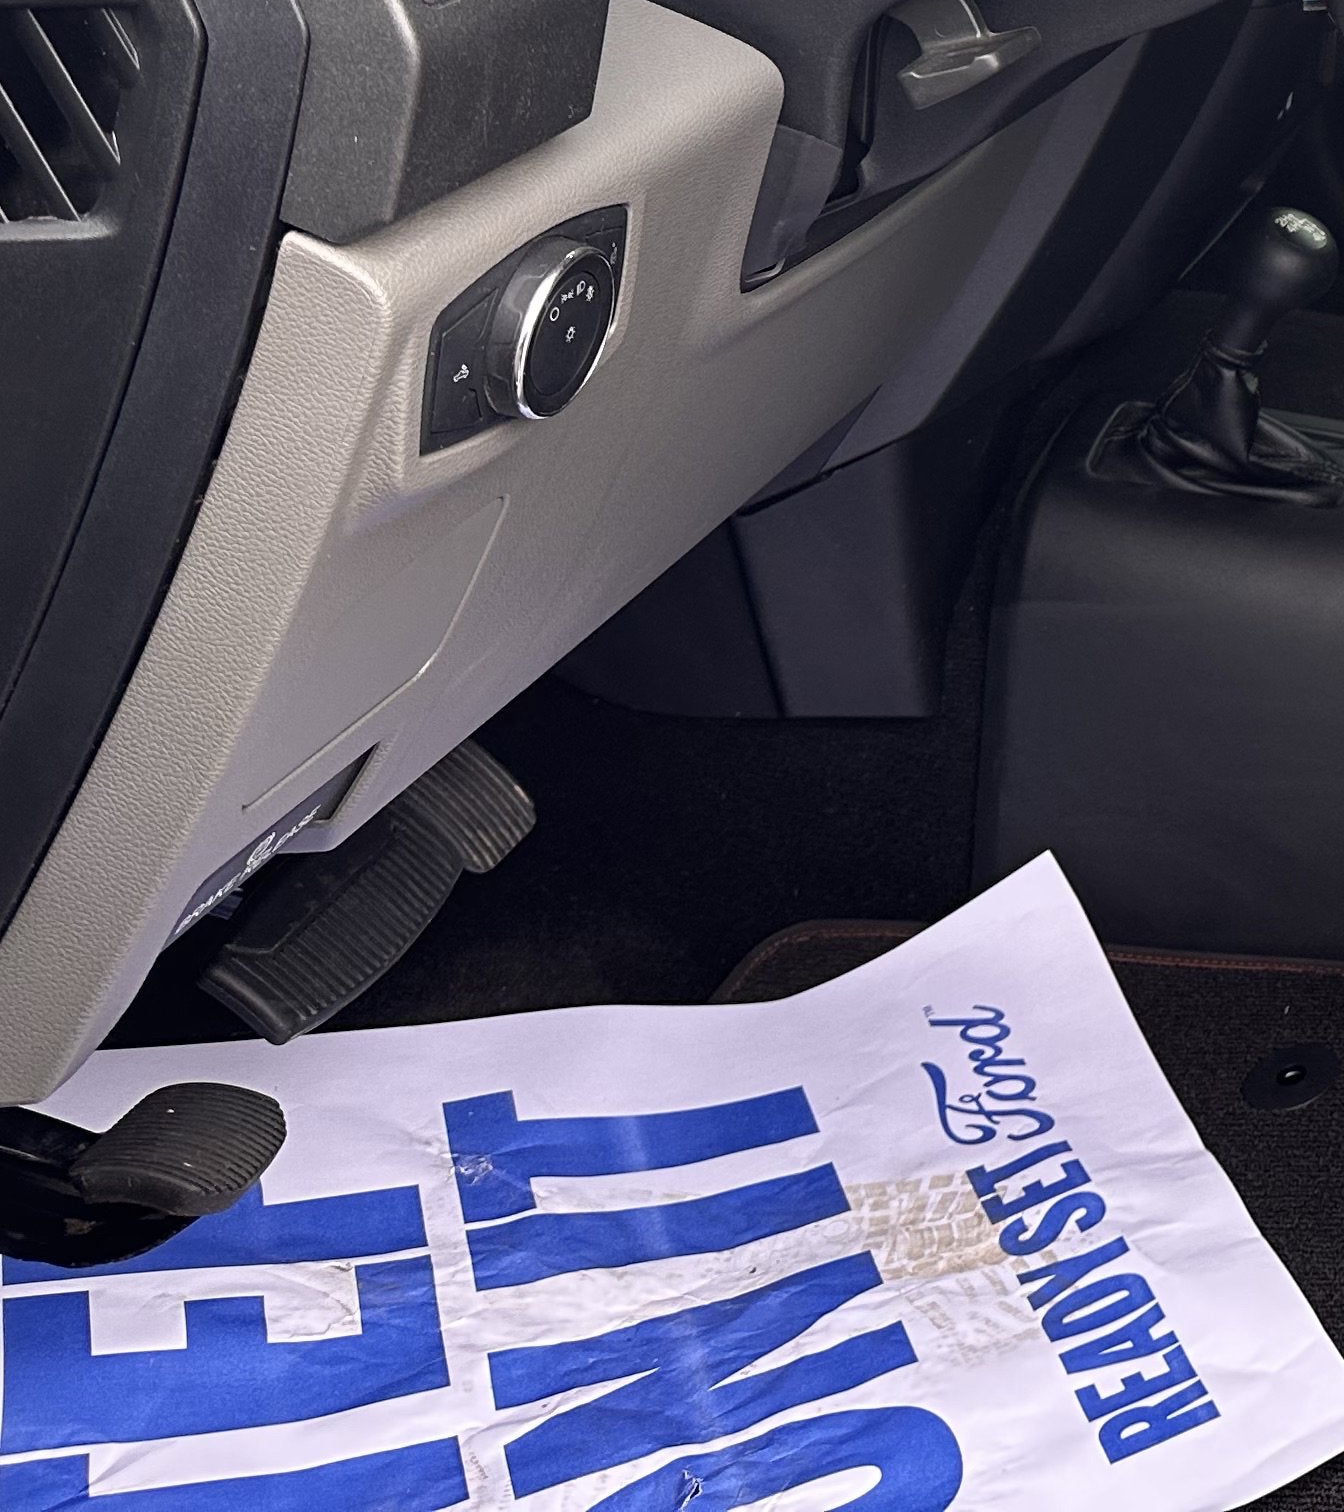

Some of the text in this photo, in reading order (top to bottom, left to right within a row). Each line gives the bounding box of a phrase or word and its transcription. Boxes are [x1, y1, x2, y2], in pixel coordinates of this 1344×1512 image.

[920, 1005, 1055, 1145] Ford
[442, 1085, 852, 1291] IT
[966, 1140, 1107, 1256] SET
[1016, 1235, 1221, 1465] READY
